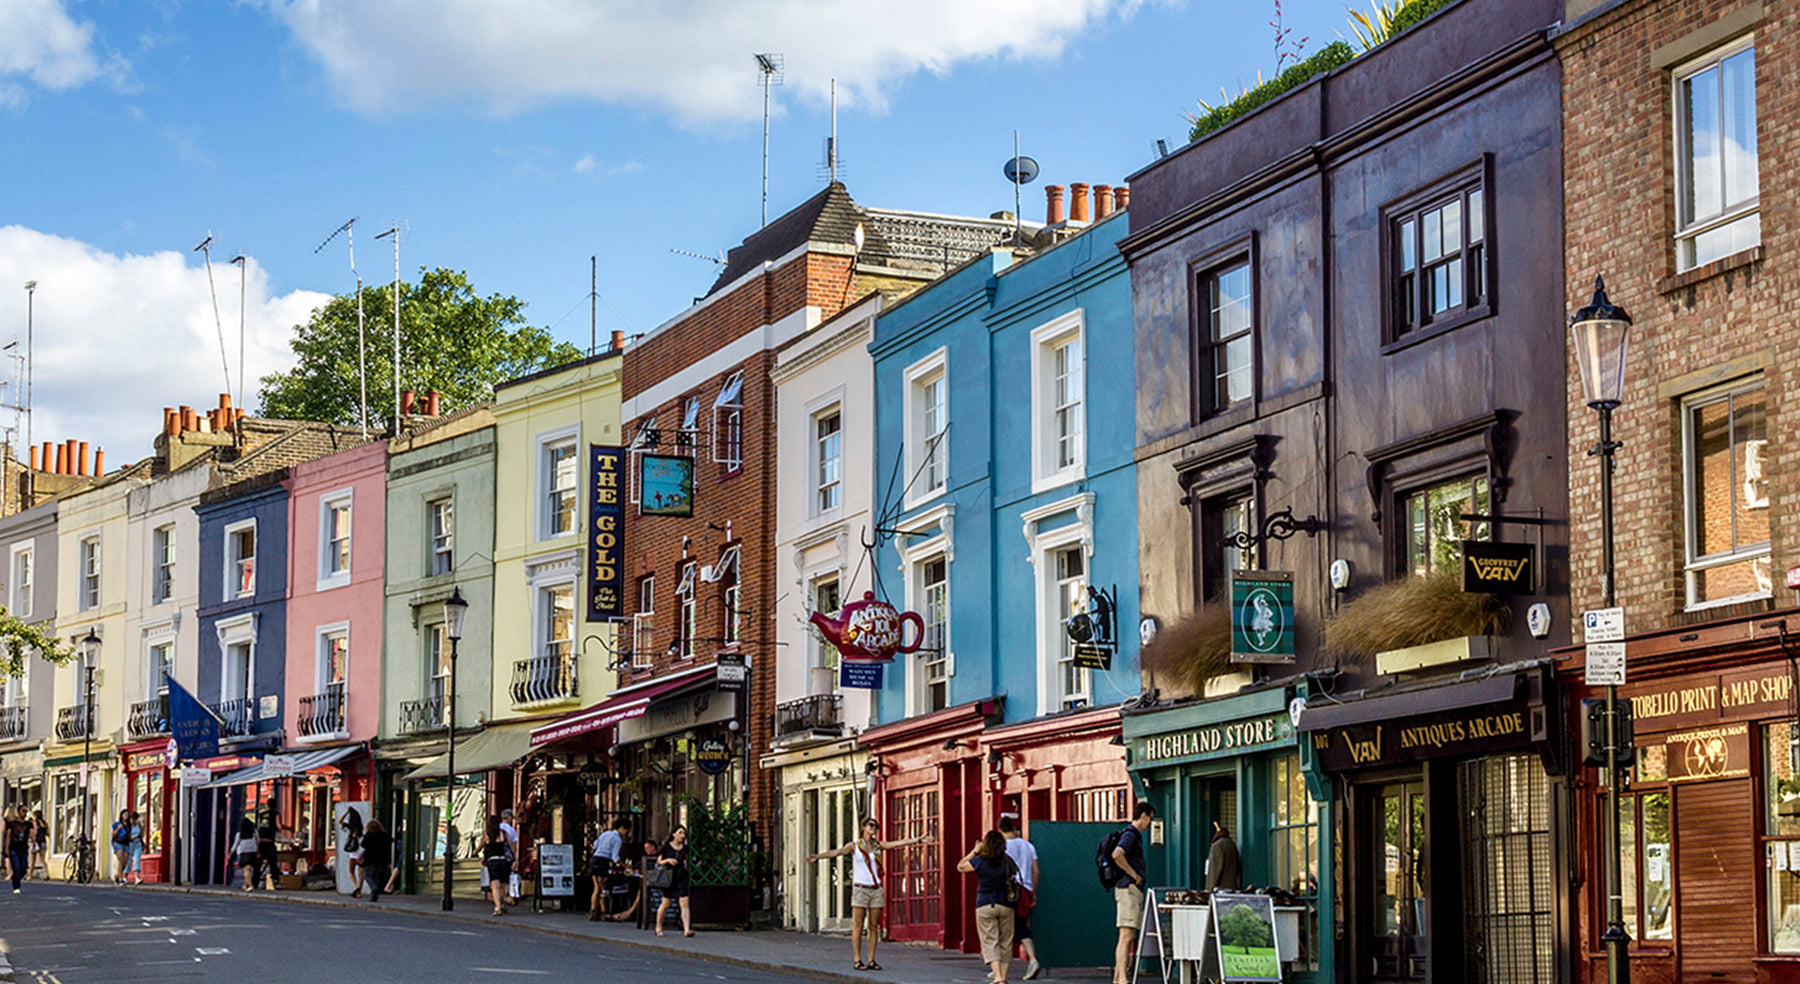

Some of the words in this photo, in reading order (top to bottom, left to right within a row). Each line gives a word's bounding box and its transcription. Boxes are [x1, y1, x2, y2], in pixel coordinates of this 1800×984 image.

[597, 455, 618, 504] THE
[595, 515, 617, 581] GOLD
[1478, 557, 1518, 568] GEOFFREY
[1468, 555, 1529, 582] VAN
[875, 618, 891, 634] 101
[1631, 691, 1678, 719] TOBELLO
[1681, 685, 1717, 714] PRINT
[1721, 686, 1730, 708] &
[1731, 680, 1758, 706] MAP
[1761, 675, 1793, 703] SHOP
[1146, 729, 1221, 760] HIGHLAND
[1226, 719, 1274, 748] STORE
[1342, 725, 1383, 763] VAN
[1400, 720, 1466, 749] ANTIQUES
[1468, 712, 1525, 739] ARCADE
[1727, 725, 1748, 736] MAPS
